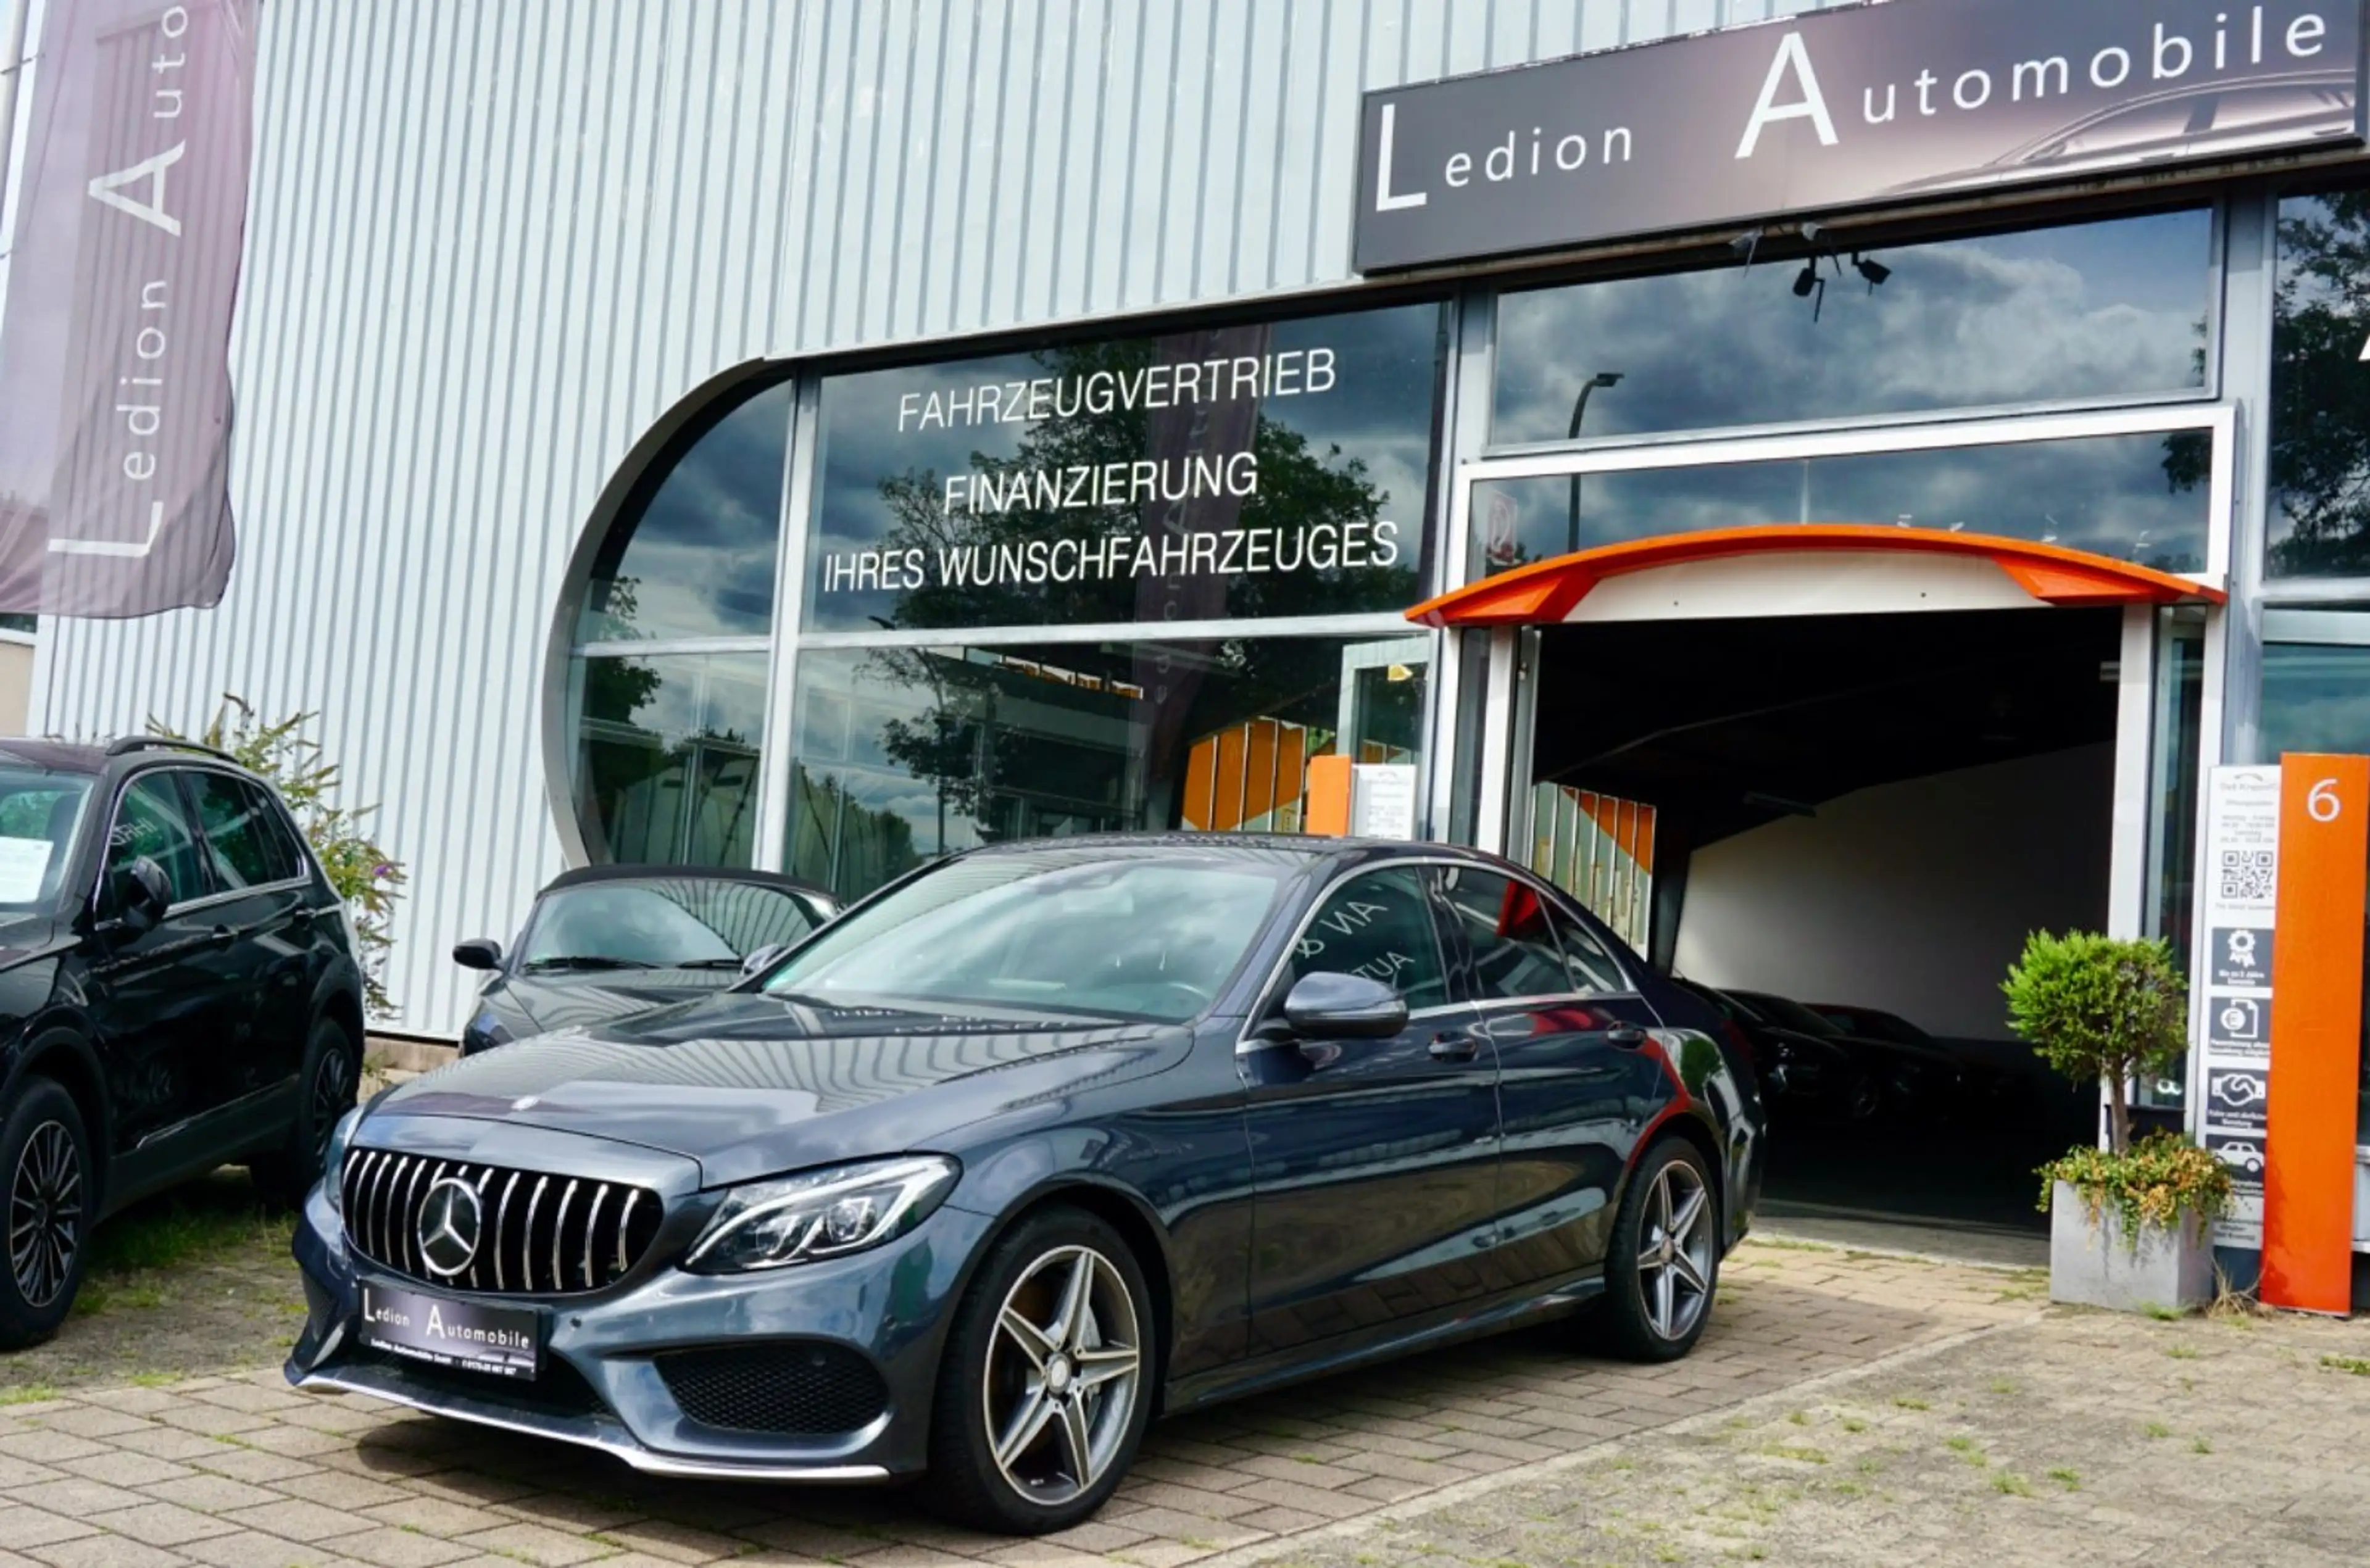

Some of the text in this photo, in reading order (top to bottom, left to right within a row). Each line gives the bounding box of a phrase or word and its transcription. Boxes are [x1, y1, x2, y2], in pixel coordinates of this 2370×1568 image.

[1376, 6, 2325, 212] Ledion Automobile
[48, 5, 188, 557] Ledion Auto
[897, 347, 1336, 431] FAHRZEUGVERTRIEB
[944, 451, 1258, 514] FINANZIERUNG
[823, 521, 1399, 592] IHRES WUNSCHFAHRZEUGES
[2306, 778, 2341, 823] 6
[364, 1287, 529, 1349] Ledion Automobile
